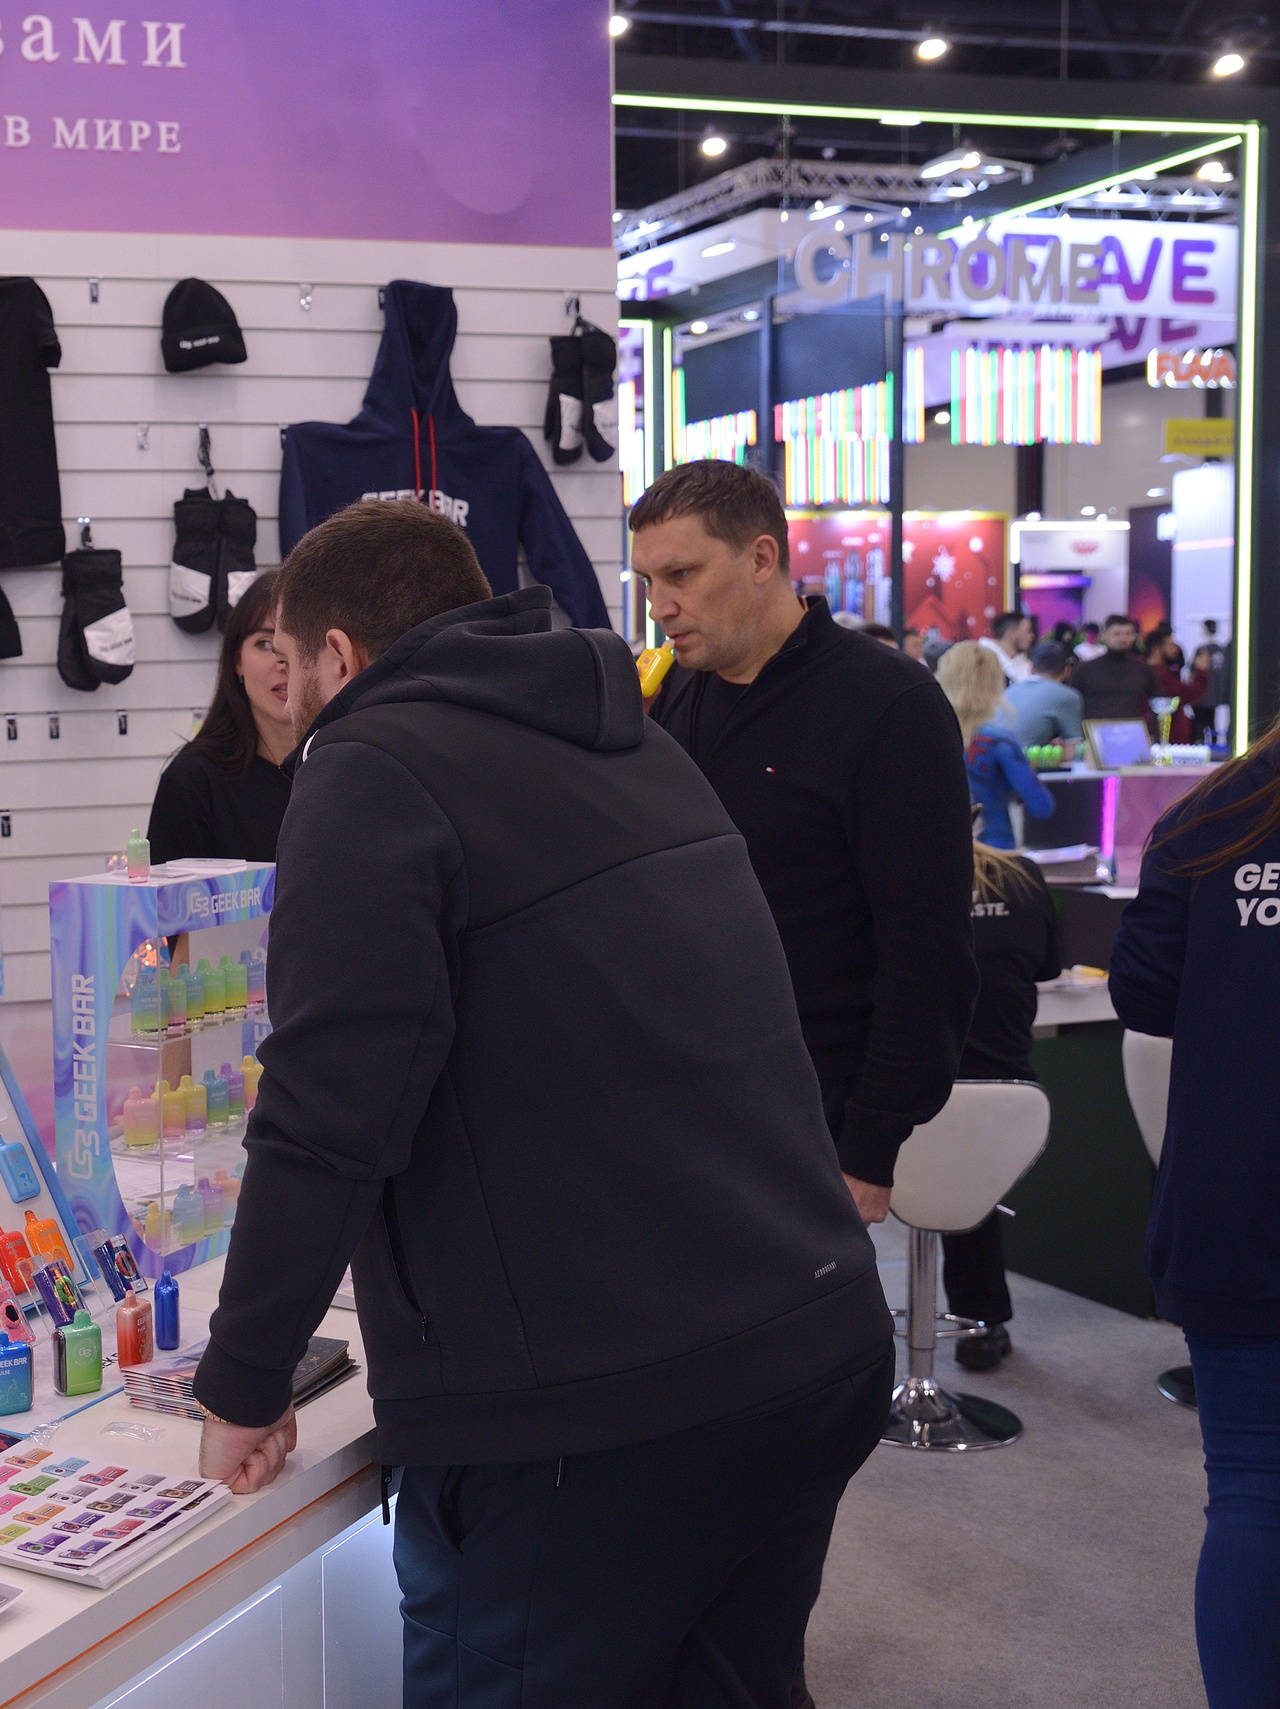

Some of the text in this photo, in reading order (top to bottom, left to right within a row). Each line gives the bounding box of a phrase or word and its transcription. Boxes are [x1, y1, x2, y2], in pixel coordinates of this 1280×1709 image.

[4, 114, 32, 148] В
[52, 116, 182, 154] МИРЕ
[211, 887, 261, 914] GEEK BAR
[71, 974, 98, 1122] GEEK BAR
[13, 1356, 28, 1366] BAR
